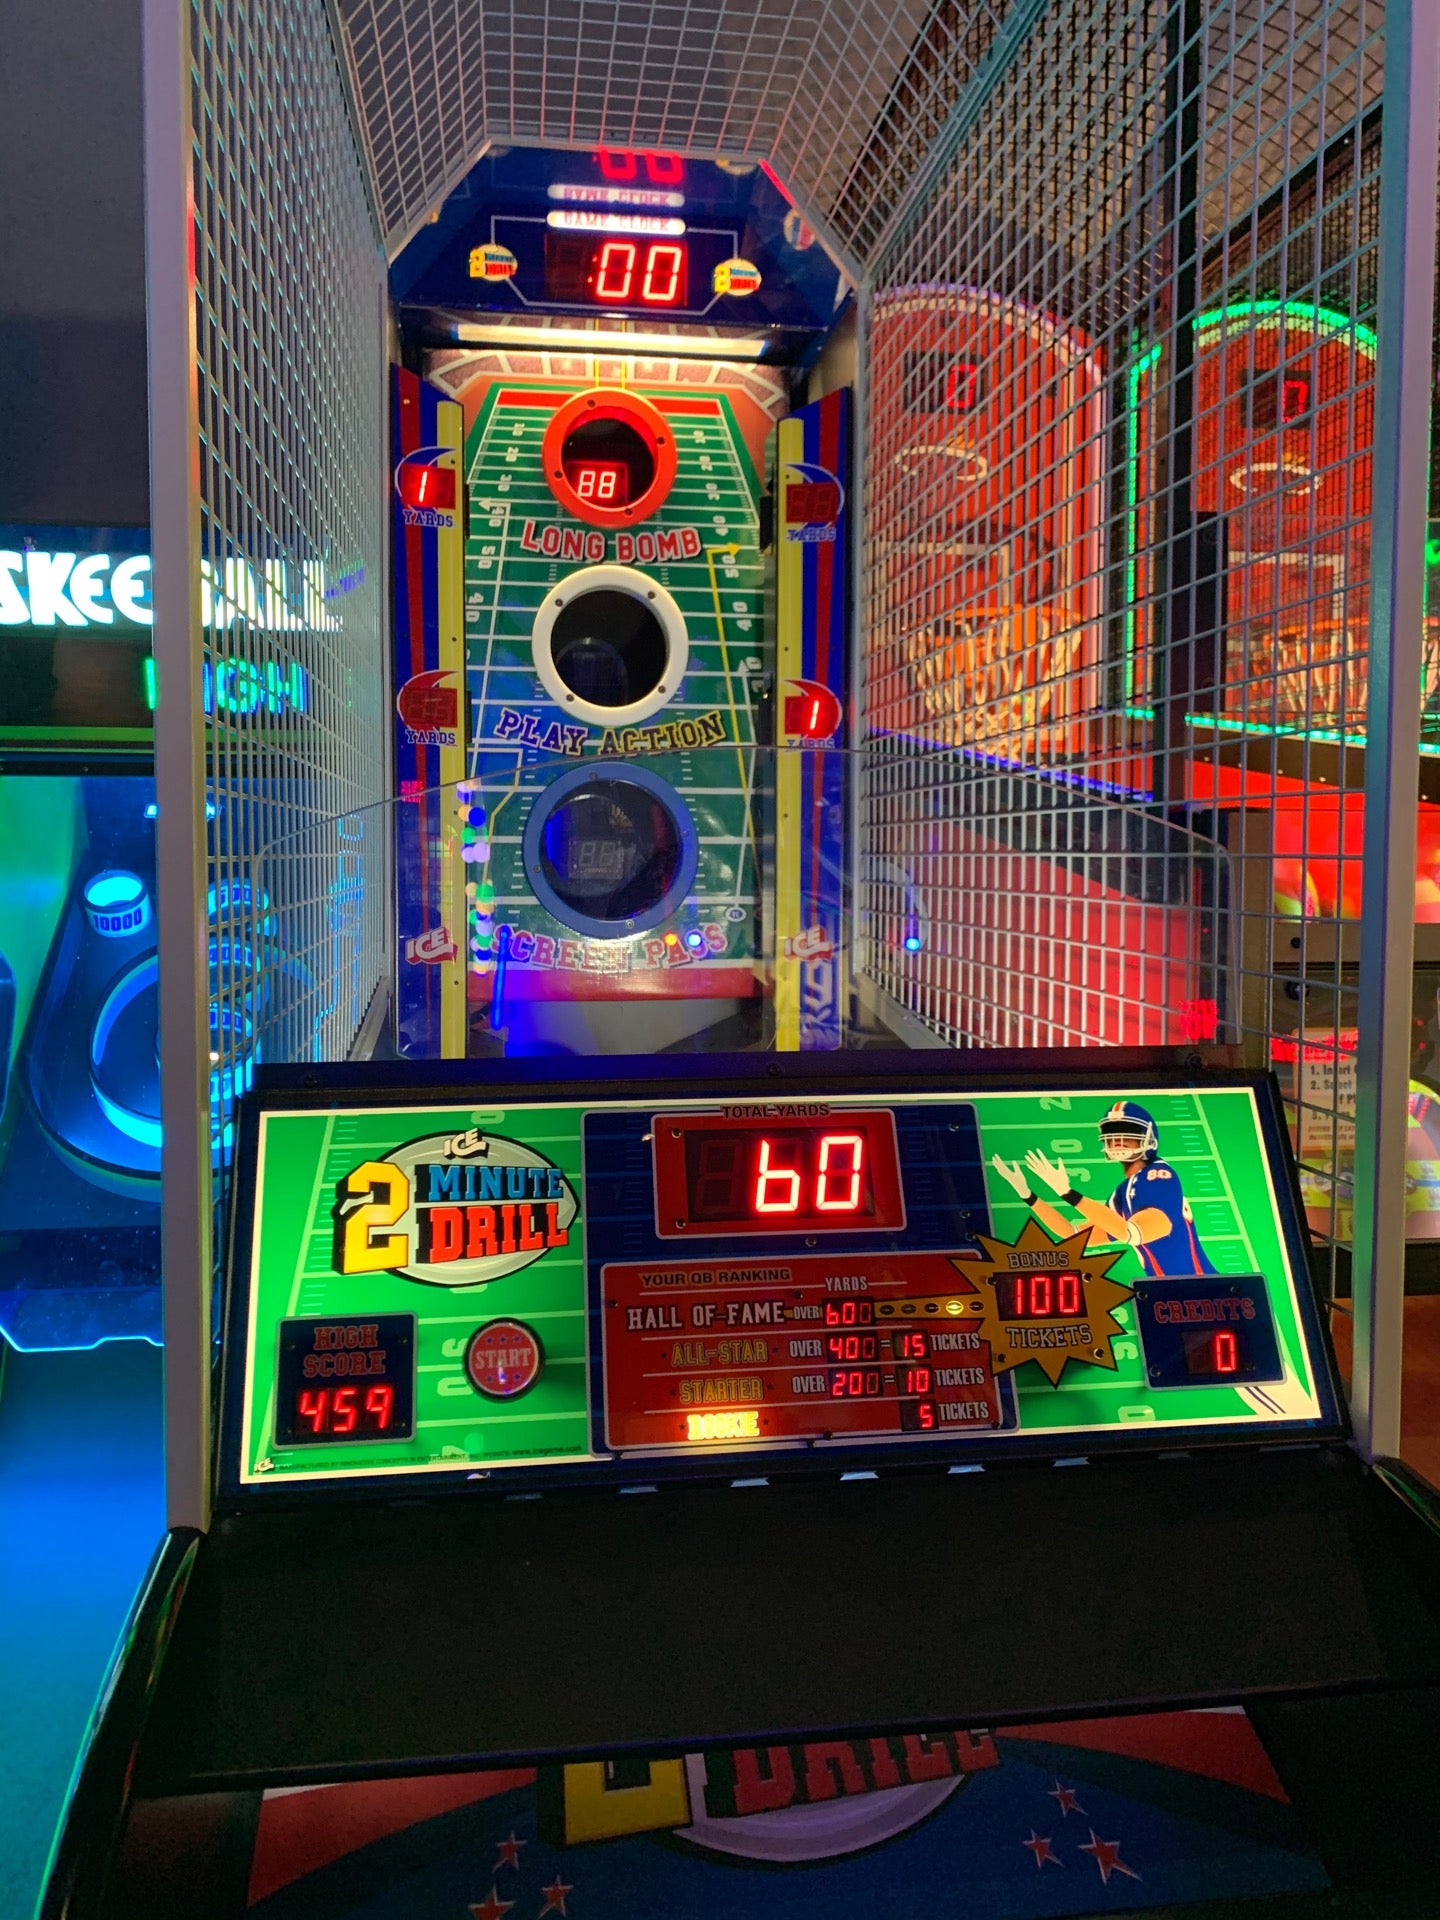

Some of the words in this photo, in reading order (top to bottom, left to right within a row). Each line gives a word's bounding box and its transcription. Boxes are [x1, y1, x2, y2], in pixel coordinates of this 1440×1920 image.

[577, 469, 617, 500] 88
[402, 509, 454, 528] YARDS
[520, 519, 606, 561] LONG
[617, 526, 702, 563] BOMB
[406, 730, 456, 745] YARDS
[494, 708, 591, 756] PLAY
[599, 709, 728, 757] ACTION
[93, 908, 143, 931] 10000
[404, 926, 458, 966] ICE
[491, 925, 631, 974] SCREEN
[642, 924, 728, 970] PASS
[783, 926, 834, 964] ICE
[1323, 1064, 1351, 1076] Inert
[722, 1104, 770, 1119] TOTAL
[776, 1104, 830, 1118] YARDS
[444, 1128, 488, 1157] ICE
[428, 1164, 564, 1201] MINUTE
[754, 1134, 864, 1214] 60
[1146, 1169, 1172, 1181] 80
[340, 1160, 411, 1274] 2
[428, 1202, 569, 1264] DRILL
[1007, 1250, 1070, 1269] BONUS
[642, 1273, 686, 1287] YOUR
[691, 1271, 713, 1285] QB
[717, 1267, 791, 1284] RANKING
[825, 1276, 868, 1293] YARDS
[1016, 1275, 1079, 1316] 100
[627, 1304, 683, 1331] HALL
[693, 1304, 716, 1327] OF
[724, 1301, 785, 1325] FAME
[792, 1305, 820, 1321] OVER
[825, 1301, 873, 1325] 600
[1154, 1298, 1256, 1324] CREDITS
[313, 1324, 379, 1351] HIGH
[788, 1339, 823, 1358] OVER
[828, 1335, 876, 1360] 400
[902, 1334, 926, 1359] 15
[930, 1329, 982, 1352] TICKETS
[1006, 1323, 1093, 1349] TICKETS
[302, 1350, 387, 1378] SCORE
[474, 1347, 532, 1370] START
[671, 1339, 769, 1367] ALL-STAR
[1215, 1332, 1237, 1373] 0
[679, 1377, 764, 1404] STARTER
[791, 1375, 826, 1394] OVER
[832, 1371, 879, 1396] 200
[906, 1369, 930, 1394] 10
[934, 1366, 985, 1388] TICKETS
[299, 1385, 393, 1433] 459
[919, 1404, 934, 1429] 5
[938, 1401, 990, 1422] TICKETS
[687, 1411, 761, 1441] ROOKIE
